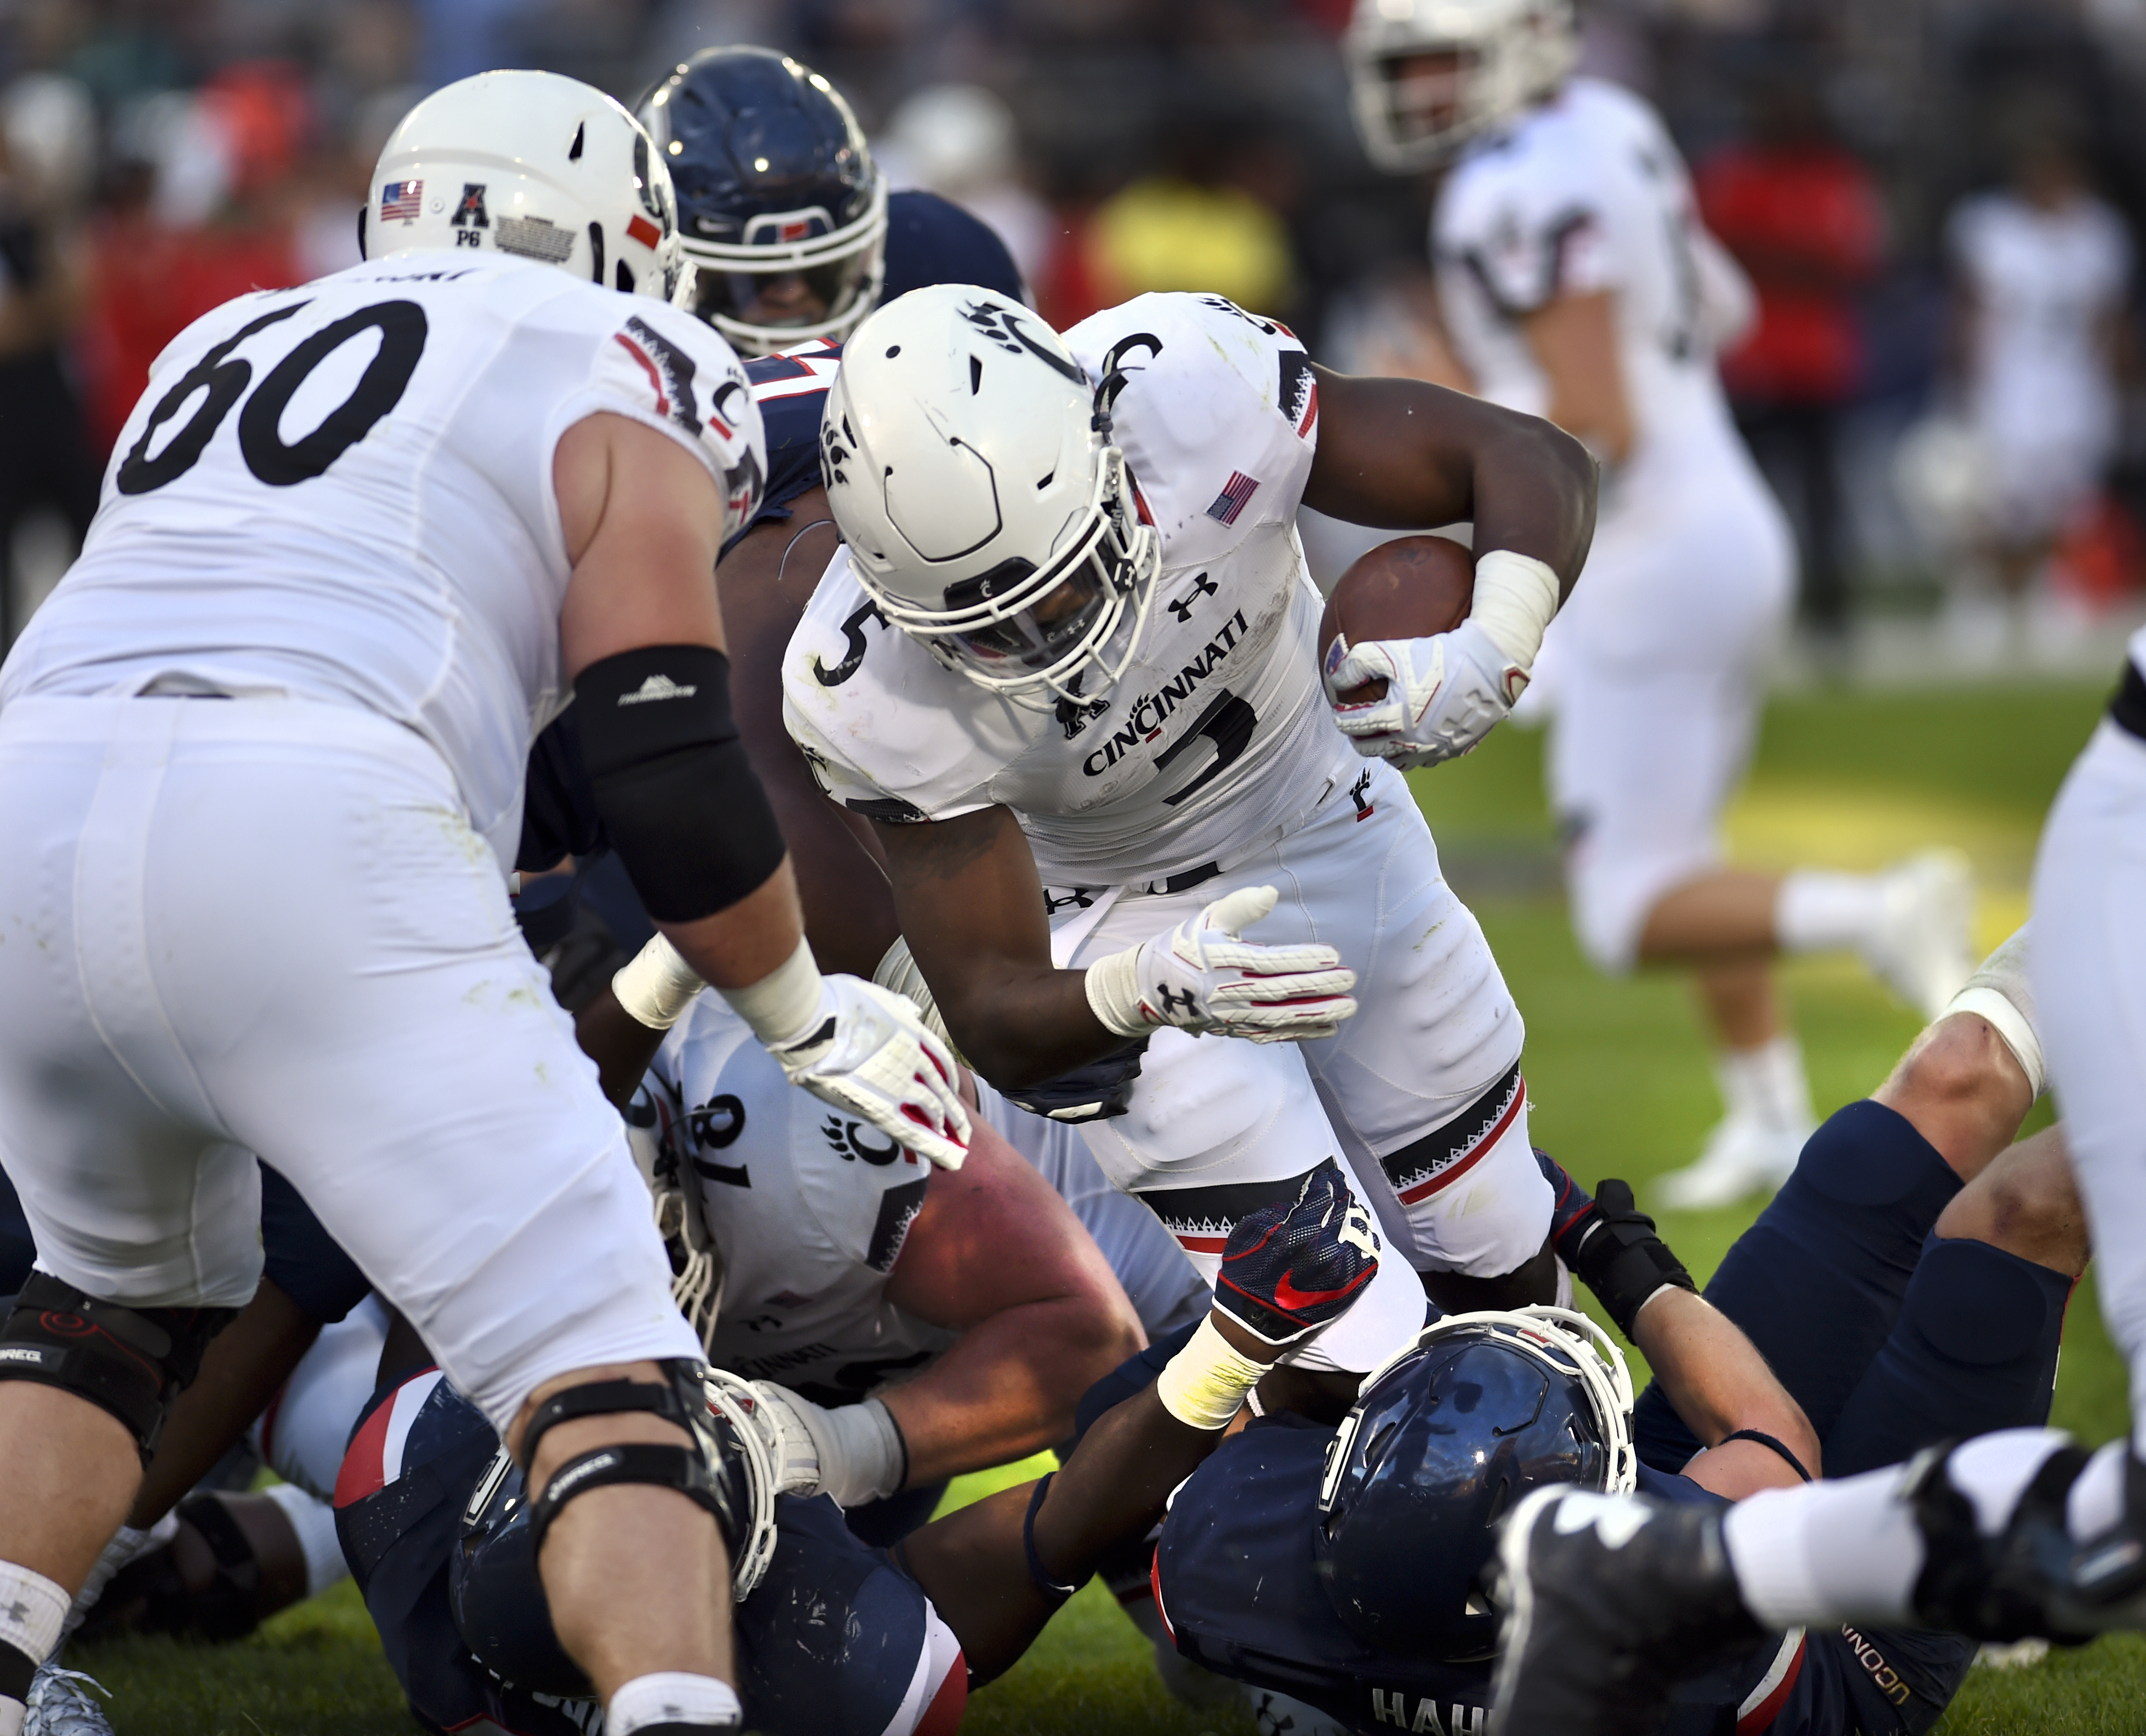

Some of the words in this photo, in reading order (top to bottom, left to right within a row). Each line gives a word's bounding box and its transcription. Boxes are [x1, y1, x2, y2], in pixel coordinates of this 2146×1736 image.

[456, 230, 481, 247] P6
[116, 298, 429, 496] 60
[1082, 608, 1249, 776] CINCINNATI
[1373, 1688, 1496, 1736] HAH
